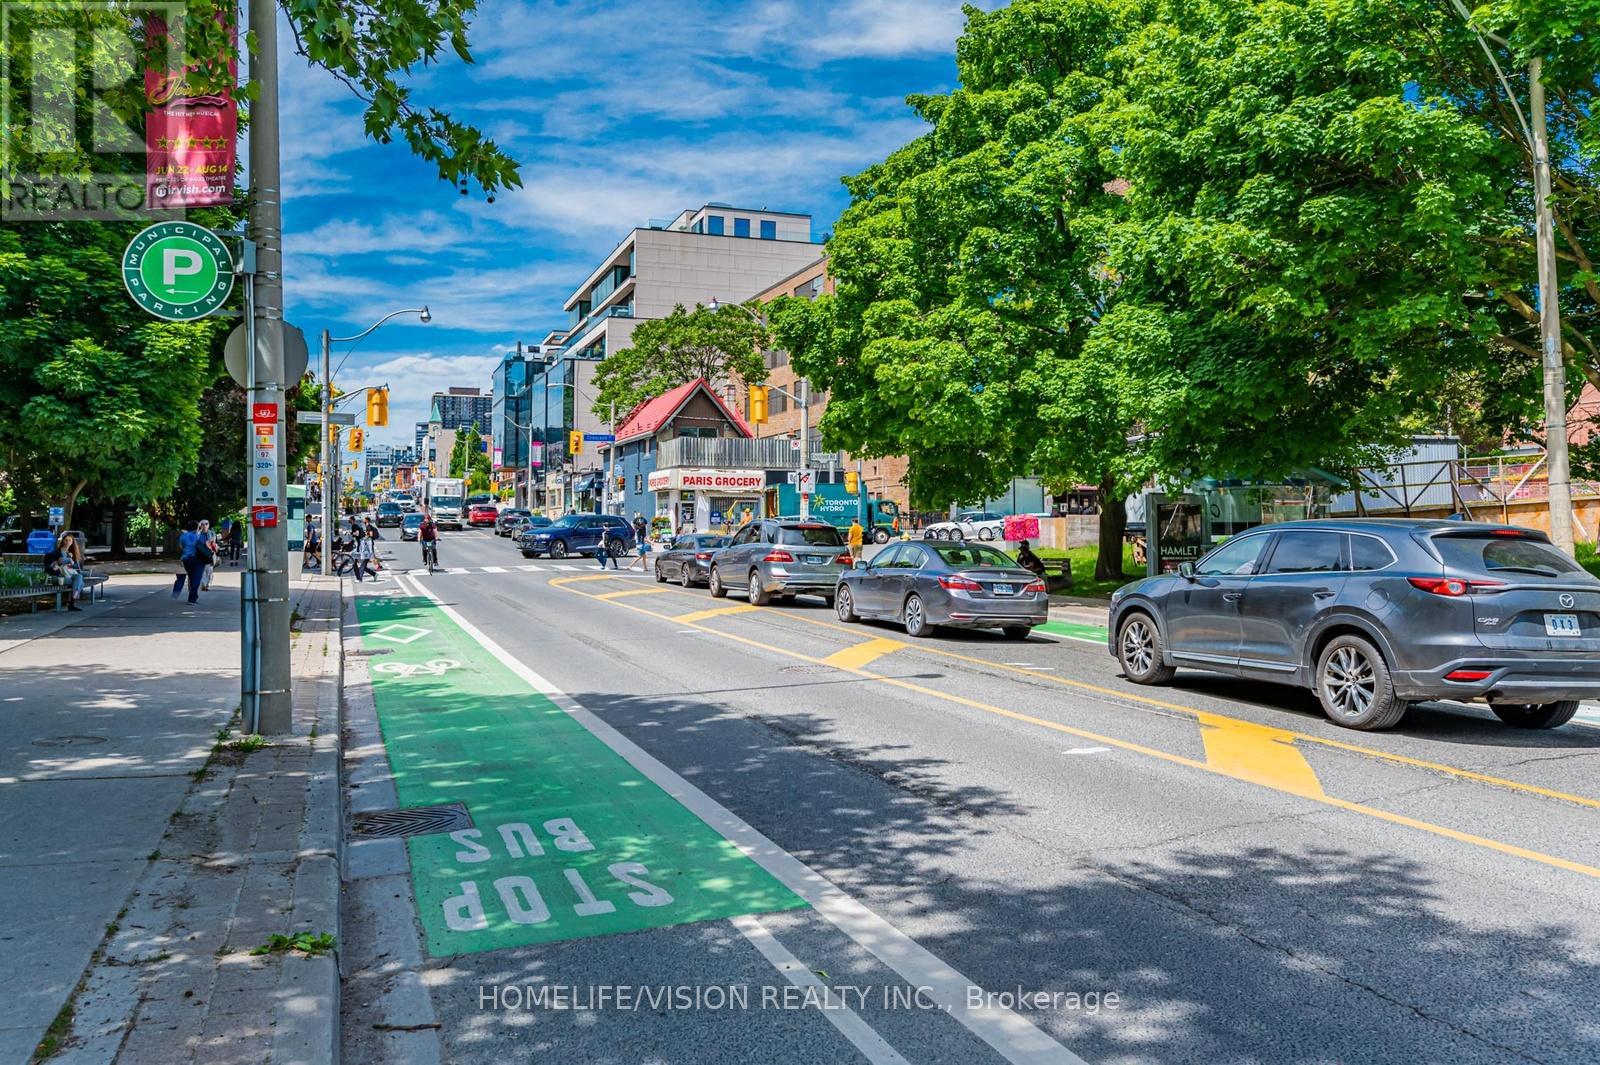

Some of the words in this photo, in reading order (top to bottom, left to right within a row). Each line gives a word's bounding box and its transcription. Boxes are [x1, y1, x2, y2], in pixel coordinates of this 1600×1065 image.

[156, 166, 174, 174] JUN
[177, 166, 188, 174] 22
[196, 165, 216, 174] AUG
[218, 164, 228, 172] 14
[130, 227, 226, 268] MUNICIPAL
[163, 248, 204, 285] P
[130, 278, 226, 316] PARKING
[683, 476, 712, 486] PARIS
[715, 477, 762, 486] GROCERY
[1160, 546, 1198, 556] HAMLET
[449, 818, 595, 862] BUS
[443, 862, 674, 932] STOP
